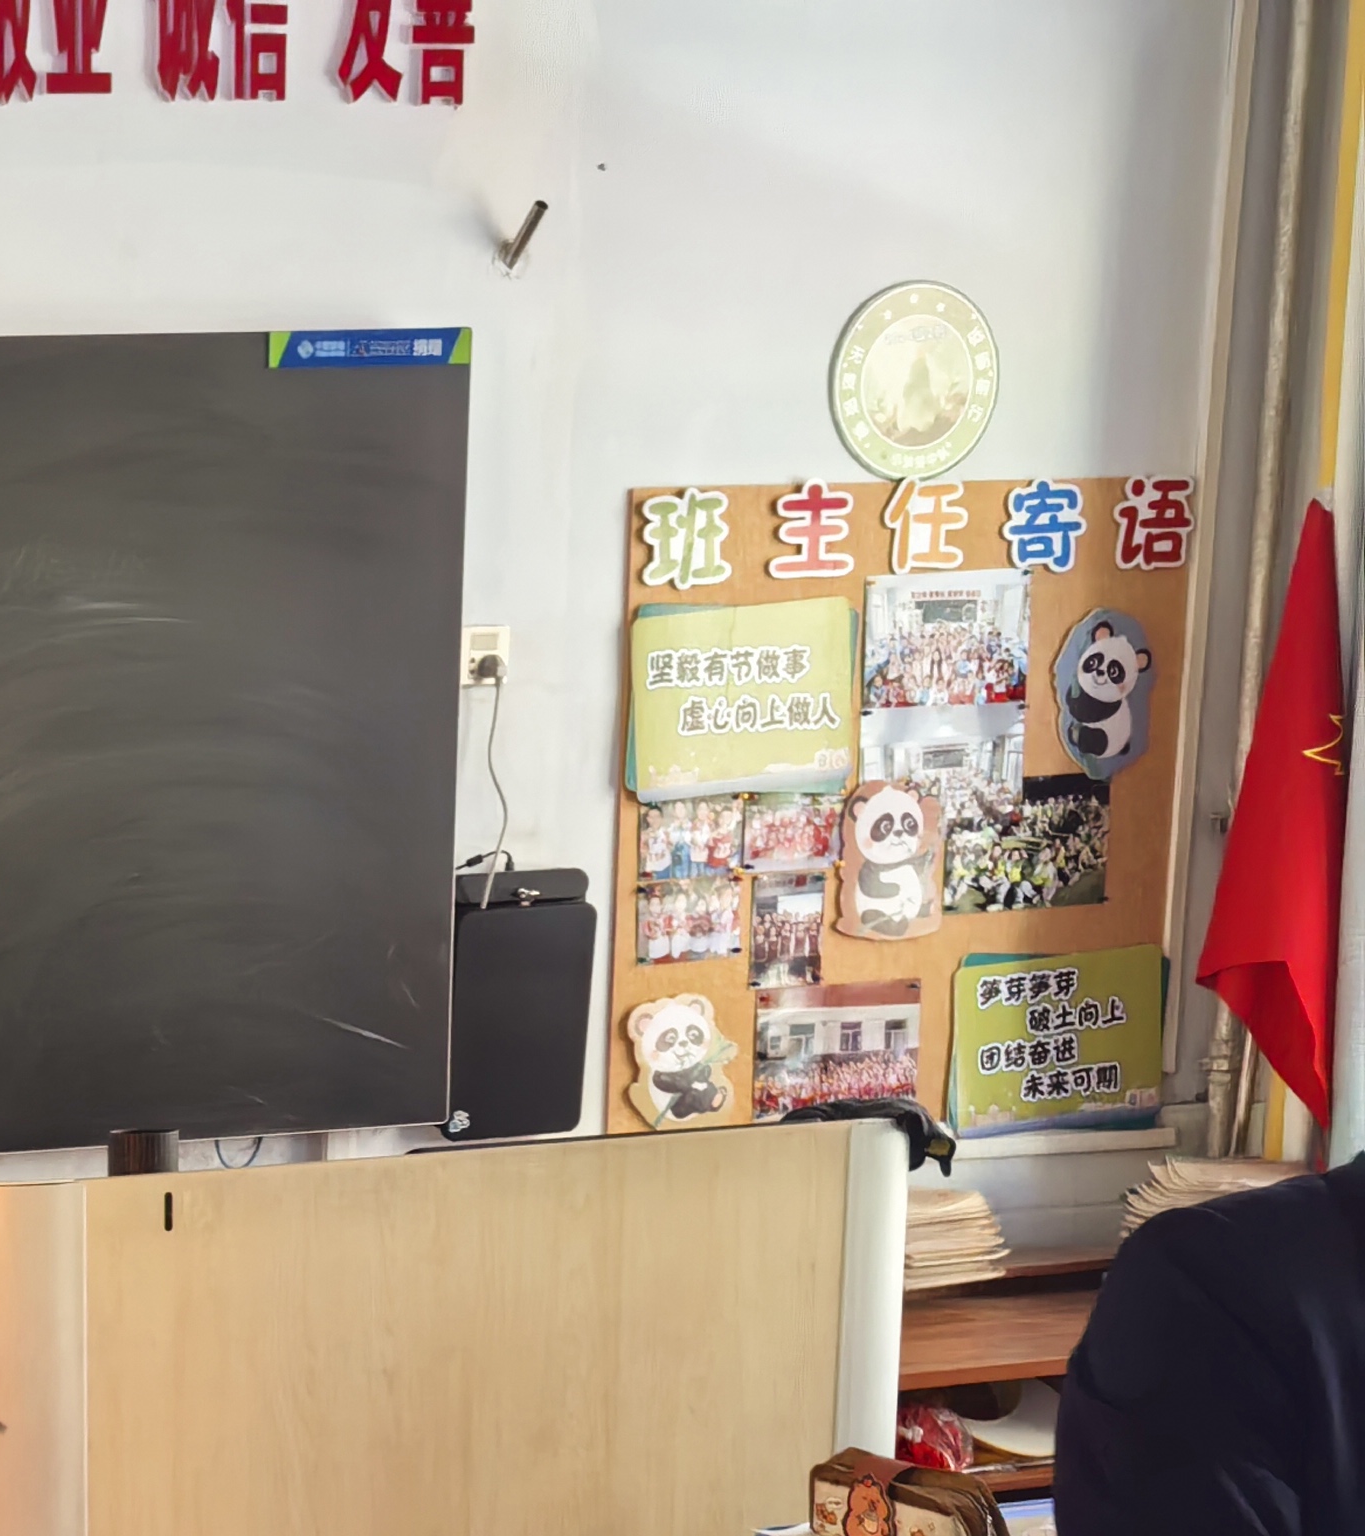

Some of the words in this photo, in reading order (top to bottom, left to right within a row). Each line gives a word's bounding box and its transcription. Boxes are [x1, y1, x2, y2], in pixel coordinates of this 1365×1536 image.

[644, 480, 1192, 587] 班主任寄语
[648, 648, 808, 686] 坚毅有节做事
[680, 695, 838, 732] 虚心向上做人
[1028, 997, 1125, 1032] 破土向上
[979, 1036, 1077, 1072] 团结奋进
[1023, 1064, 1119, 1099] 未来可期
